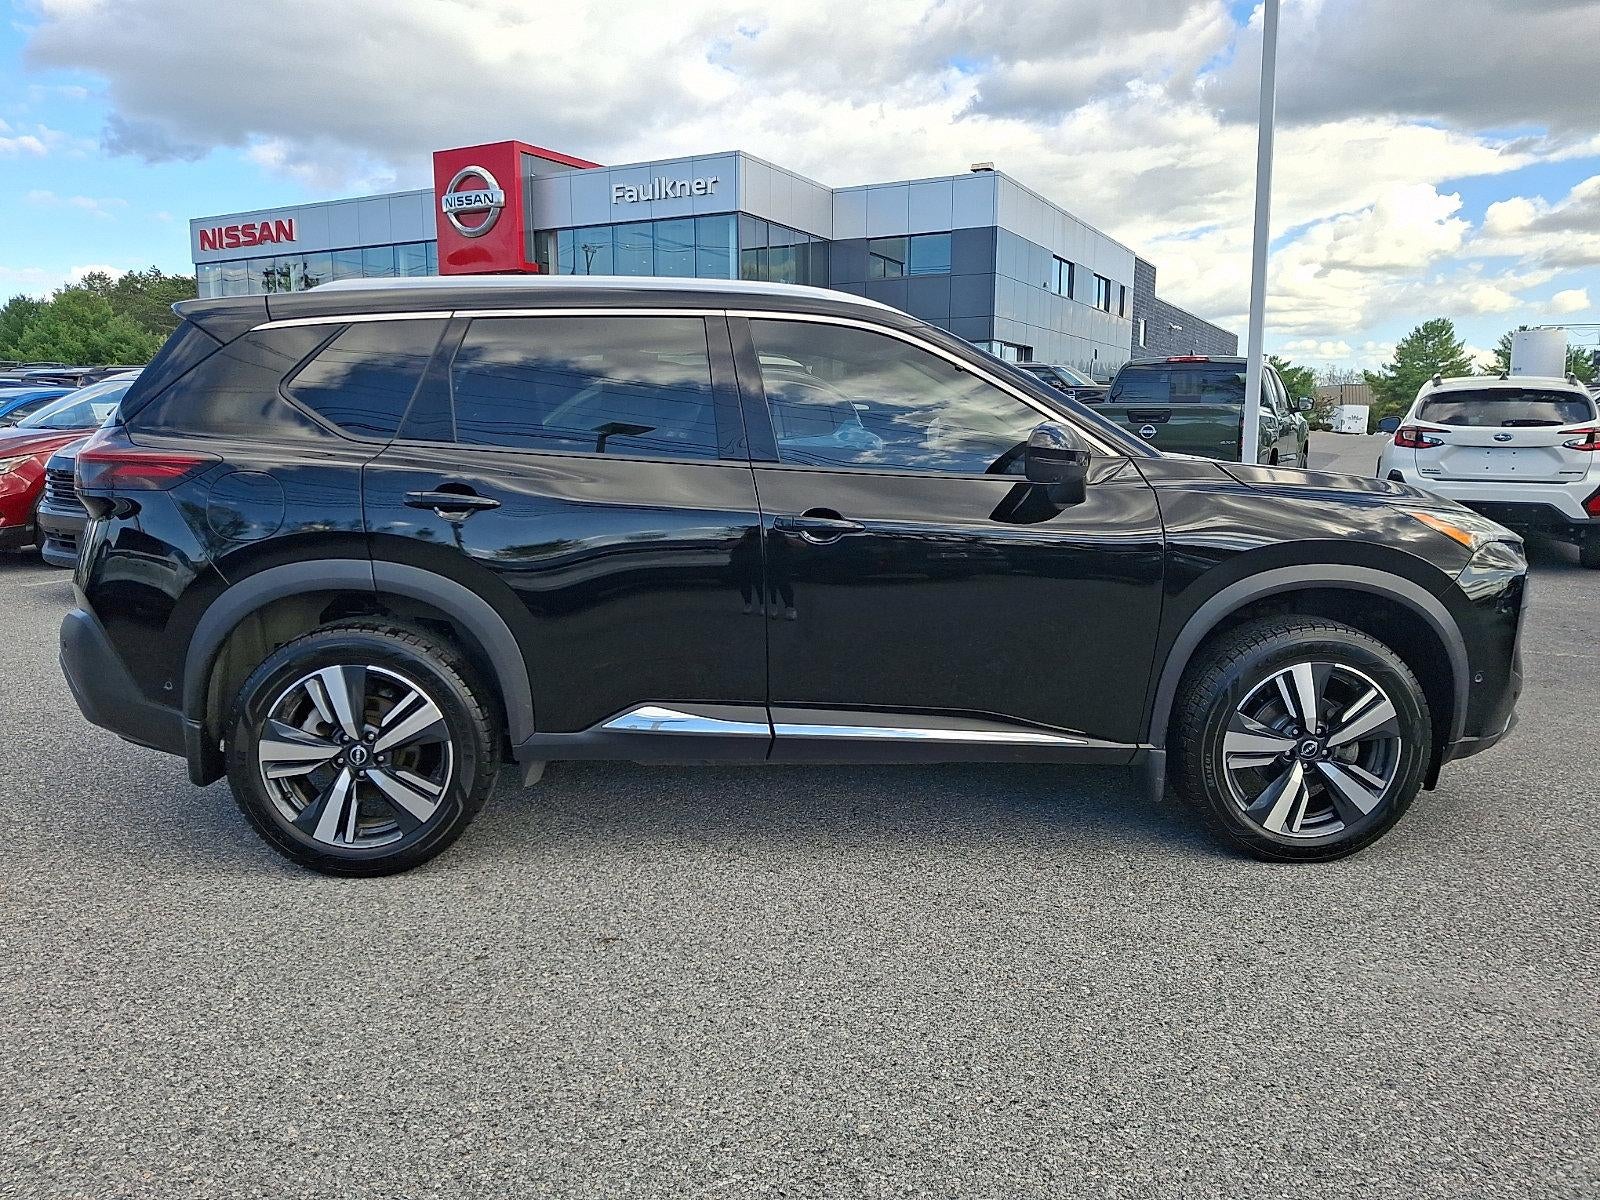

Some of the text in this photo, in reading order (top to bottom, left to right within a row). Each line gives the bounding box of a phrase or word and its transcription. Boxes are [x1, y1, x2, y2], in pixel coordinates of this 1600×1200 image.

[445, 193, 494, 208] NISSAN
[612, 176, 719, 204] Faulkner
[199, 218, 294, 251] NISSAN
